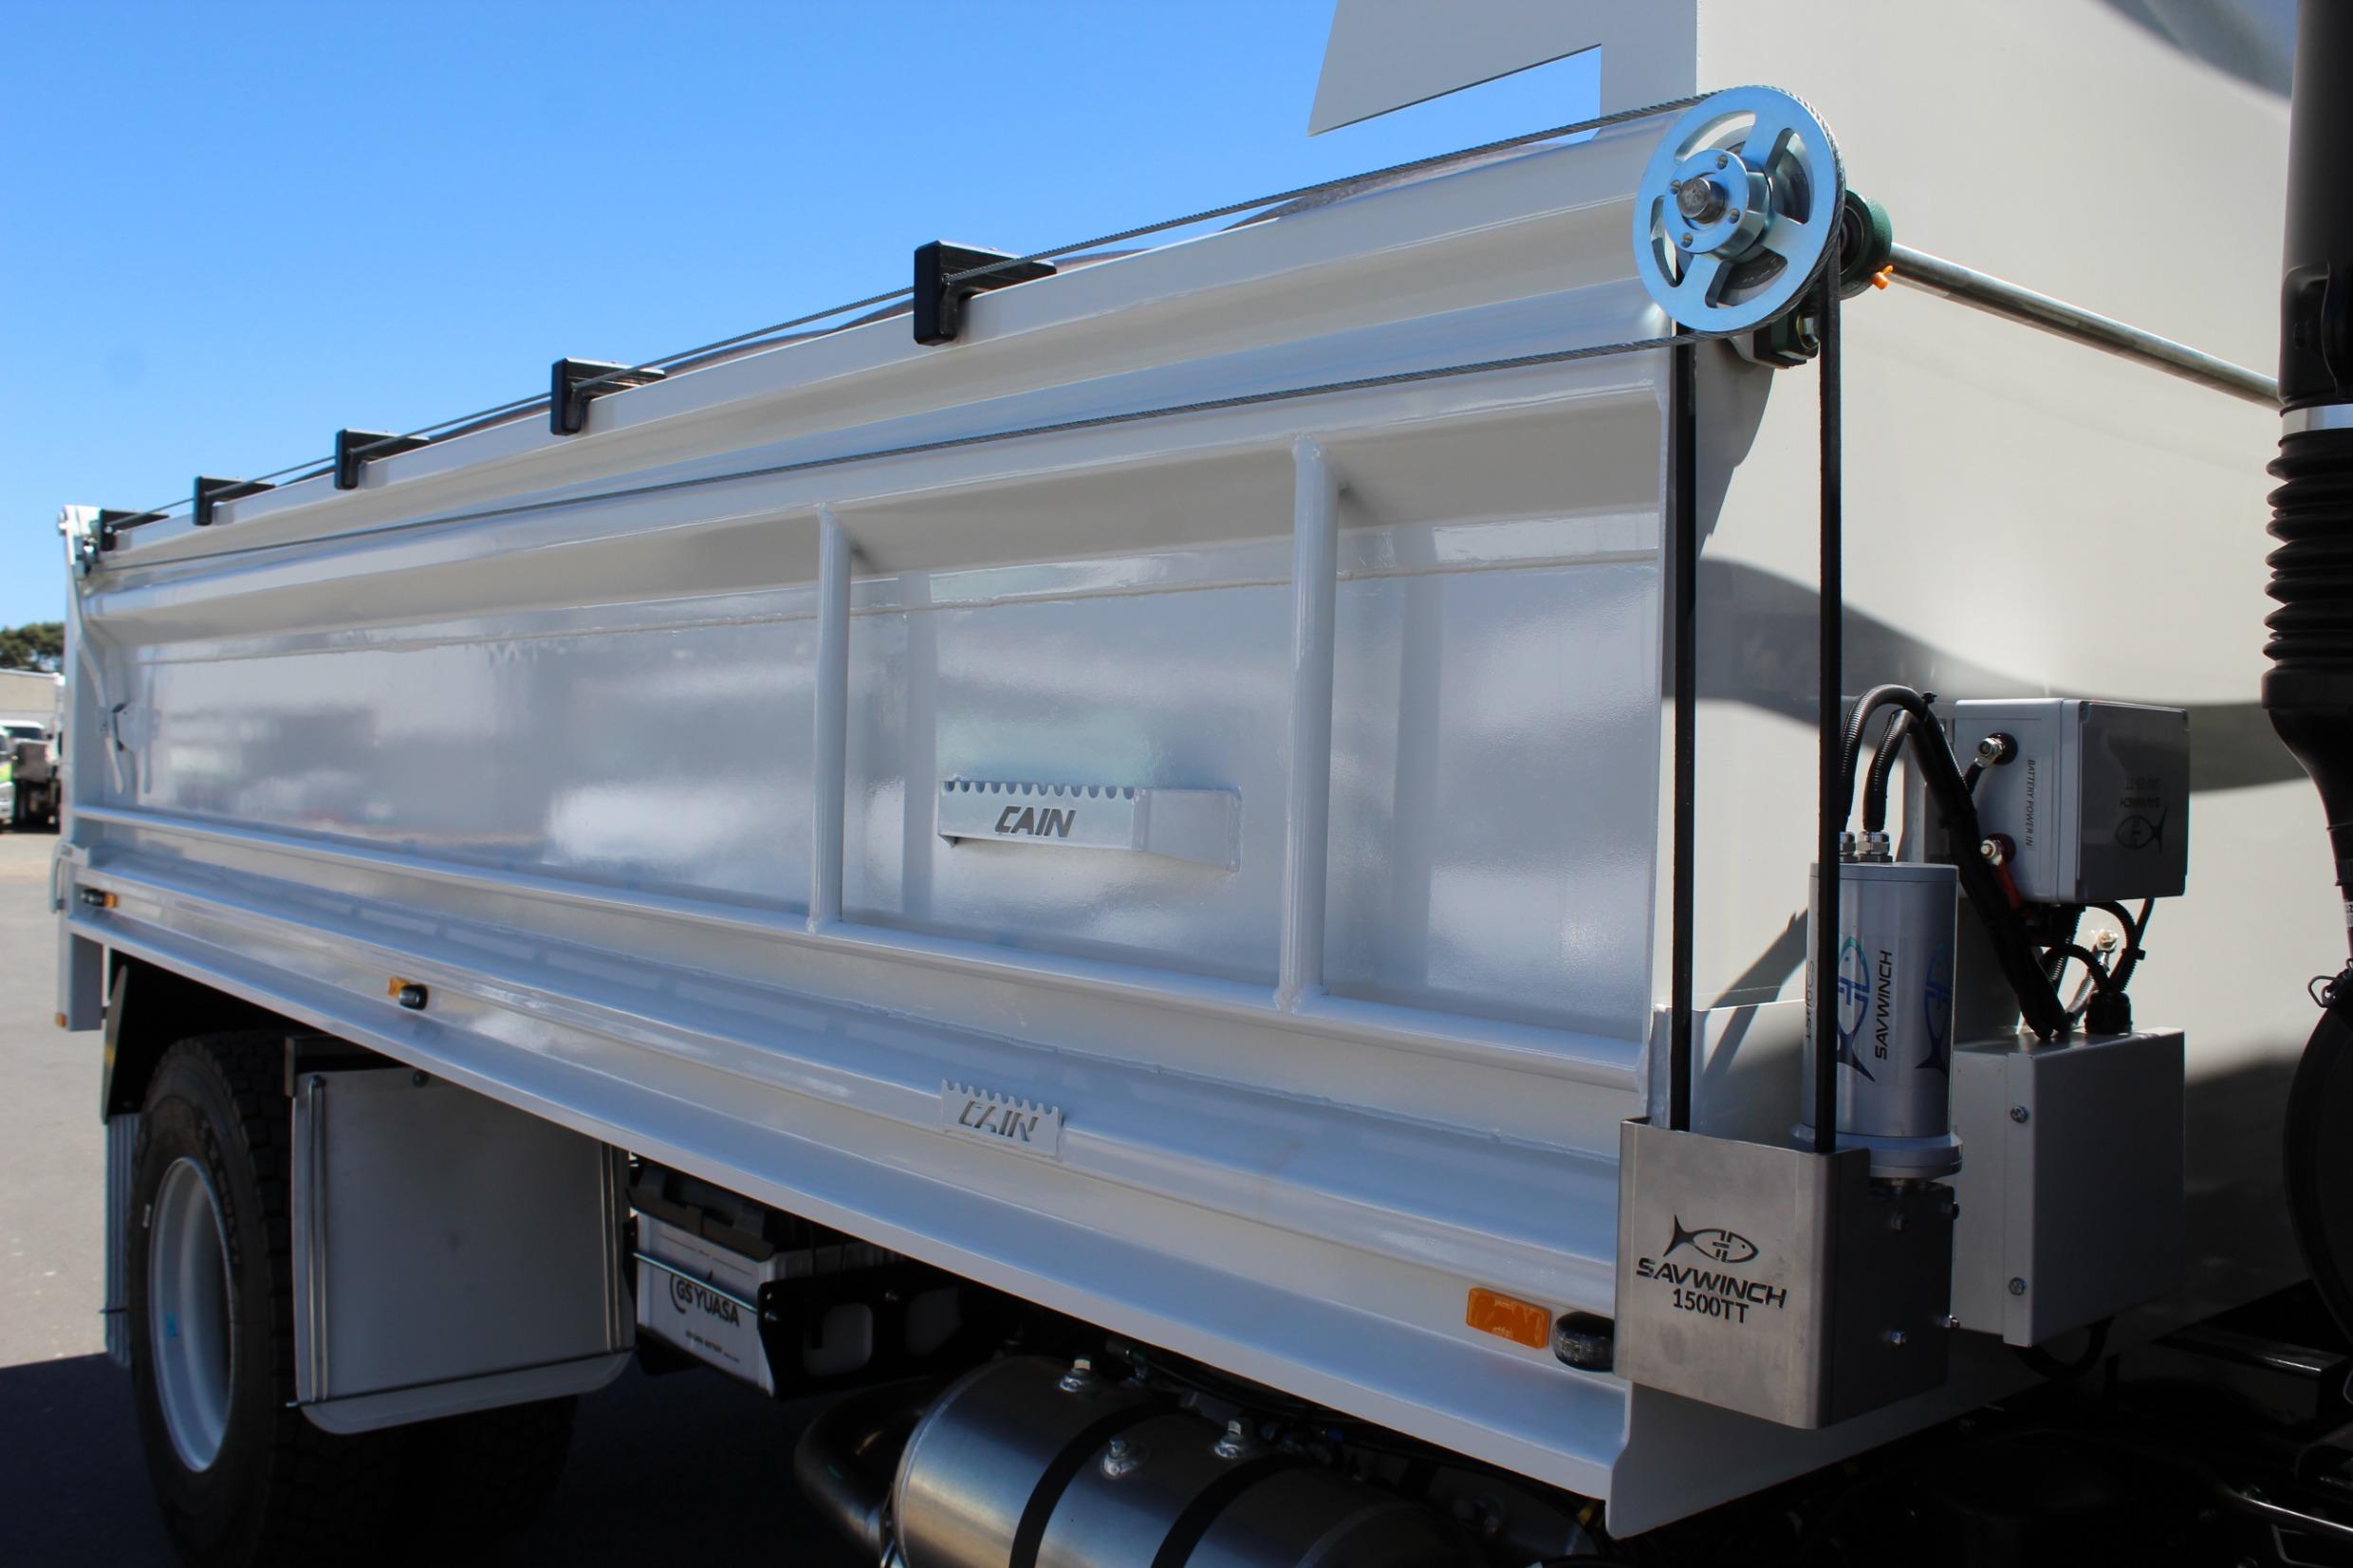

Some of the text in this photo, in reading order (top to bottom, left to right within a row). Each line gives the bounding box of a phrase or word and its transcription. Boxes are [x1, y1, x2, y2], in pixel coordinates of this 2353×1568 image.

[994, 805, 1077, 838] CAIN
[2025, 759, 2036, 847] BATTERY POWER IN
[1875, 950, 1893, 1061] SAVWINCH
[958, 1099, 1039, 1142] CAIN
[676, 1282, 739, 1327] GS YUASA
[1637, 1257, 1788, 1309] SAVWINCH
[1673, 1288, 1750, 1324] 1500TT
